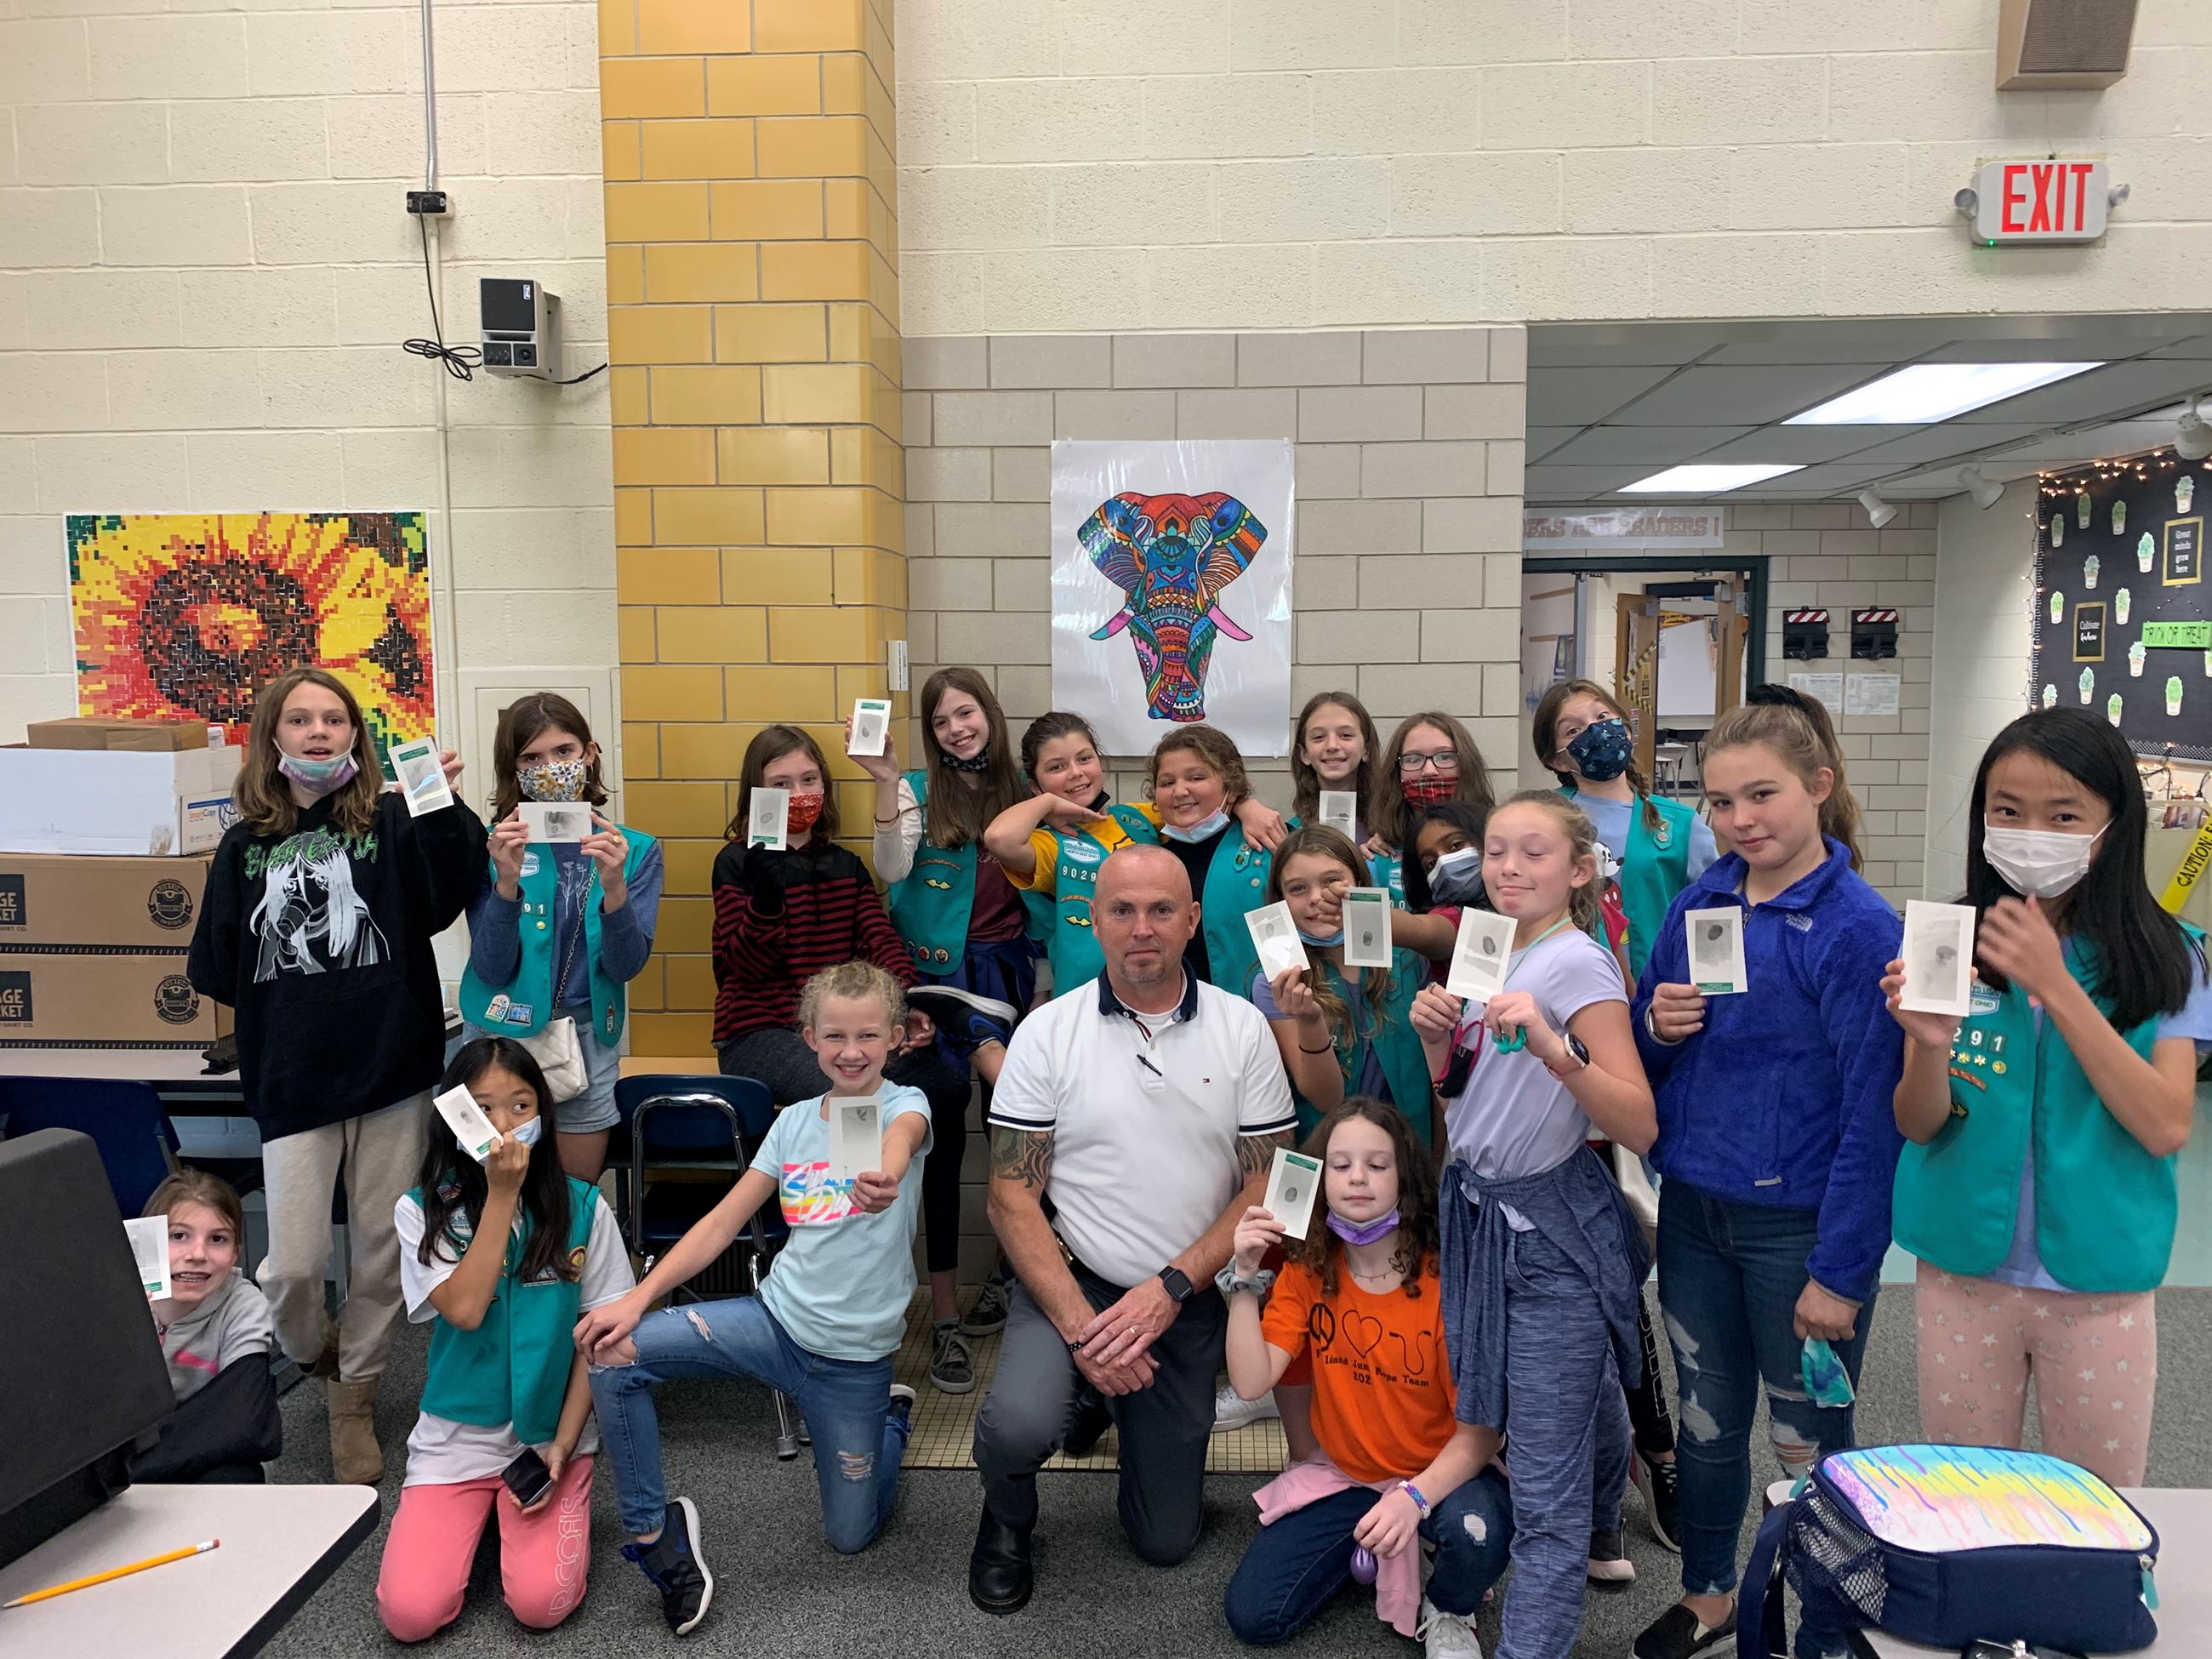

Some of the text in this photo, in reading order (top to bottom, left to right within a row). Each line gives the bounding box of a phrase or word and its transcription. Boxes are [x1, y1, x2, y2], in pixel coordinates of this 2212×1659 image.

[2001, 164, 2093, 232] EXIT
[2144, 625, 2208, 645] TRICK OR TREAT
[1975, 1000, 1993, 1008] OHIO
[1353, 1371, 1371, 1385] 202
[1402, 1374, 1429, 1388] Team
